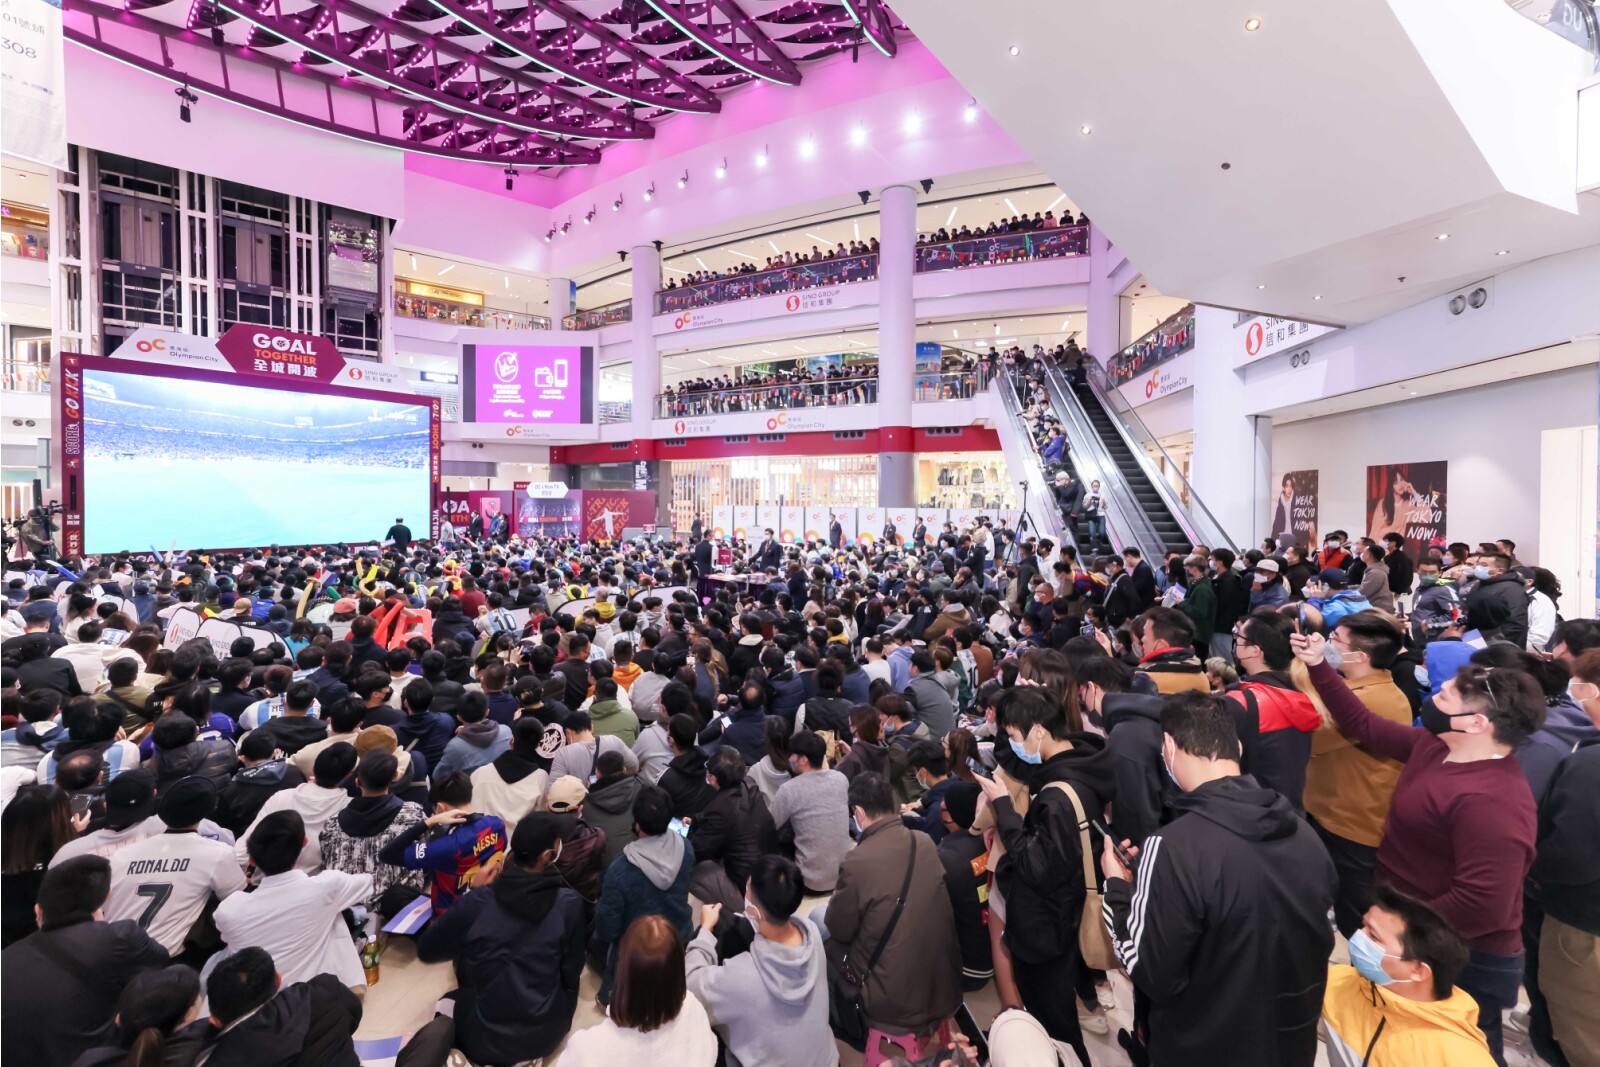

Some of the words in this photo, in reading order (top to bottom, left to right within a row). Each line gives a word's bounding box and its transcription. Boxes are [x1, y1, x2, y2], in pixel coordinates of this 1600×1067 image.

[802, 292, 818, 300] SINO
[817, 289, 841, 298] GROUP
[692, 318, 714, 328] Olympian
[712, 317, 724, 325] City
[252, 333, 318, 356] GOAL
[169, 351, 204, 361] Olympian
[204, 355, 219, 363] City
[254, 348, 317, 366] TOGETHER
[253, 358, 319, 379] 全城開波
[364, 369, 379, 377] SINO
[1160, 378, 1180, 394] Olympian
[1178, 376, 1188, 388] City
[698, 418, 717, 426] GROUP
[787, 422, 814, 430] Olympian
[813, 421, 826, 429] City
[1294, 495, 1314, 507] WEAR
[1407, 493, 1439, 509] WEAR
[1292, 507, 1316, 518] TOKYO
[1404, 510, 1443, 524] TOKYO
[1406, 526, 1438, 541] NOW!
[472, 832, 499, 857] MESSI
[126, 857, 191, 876] RONALDO
[136, 882, 174, 930] 7
